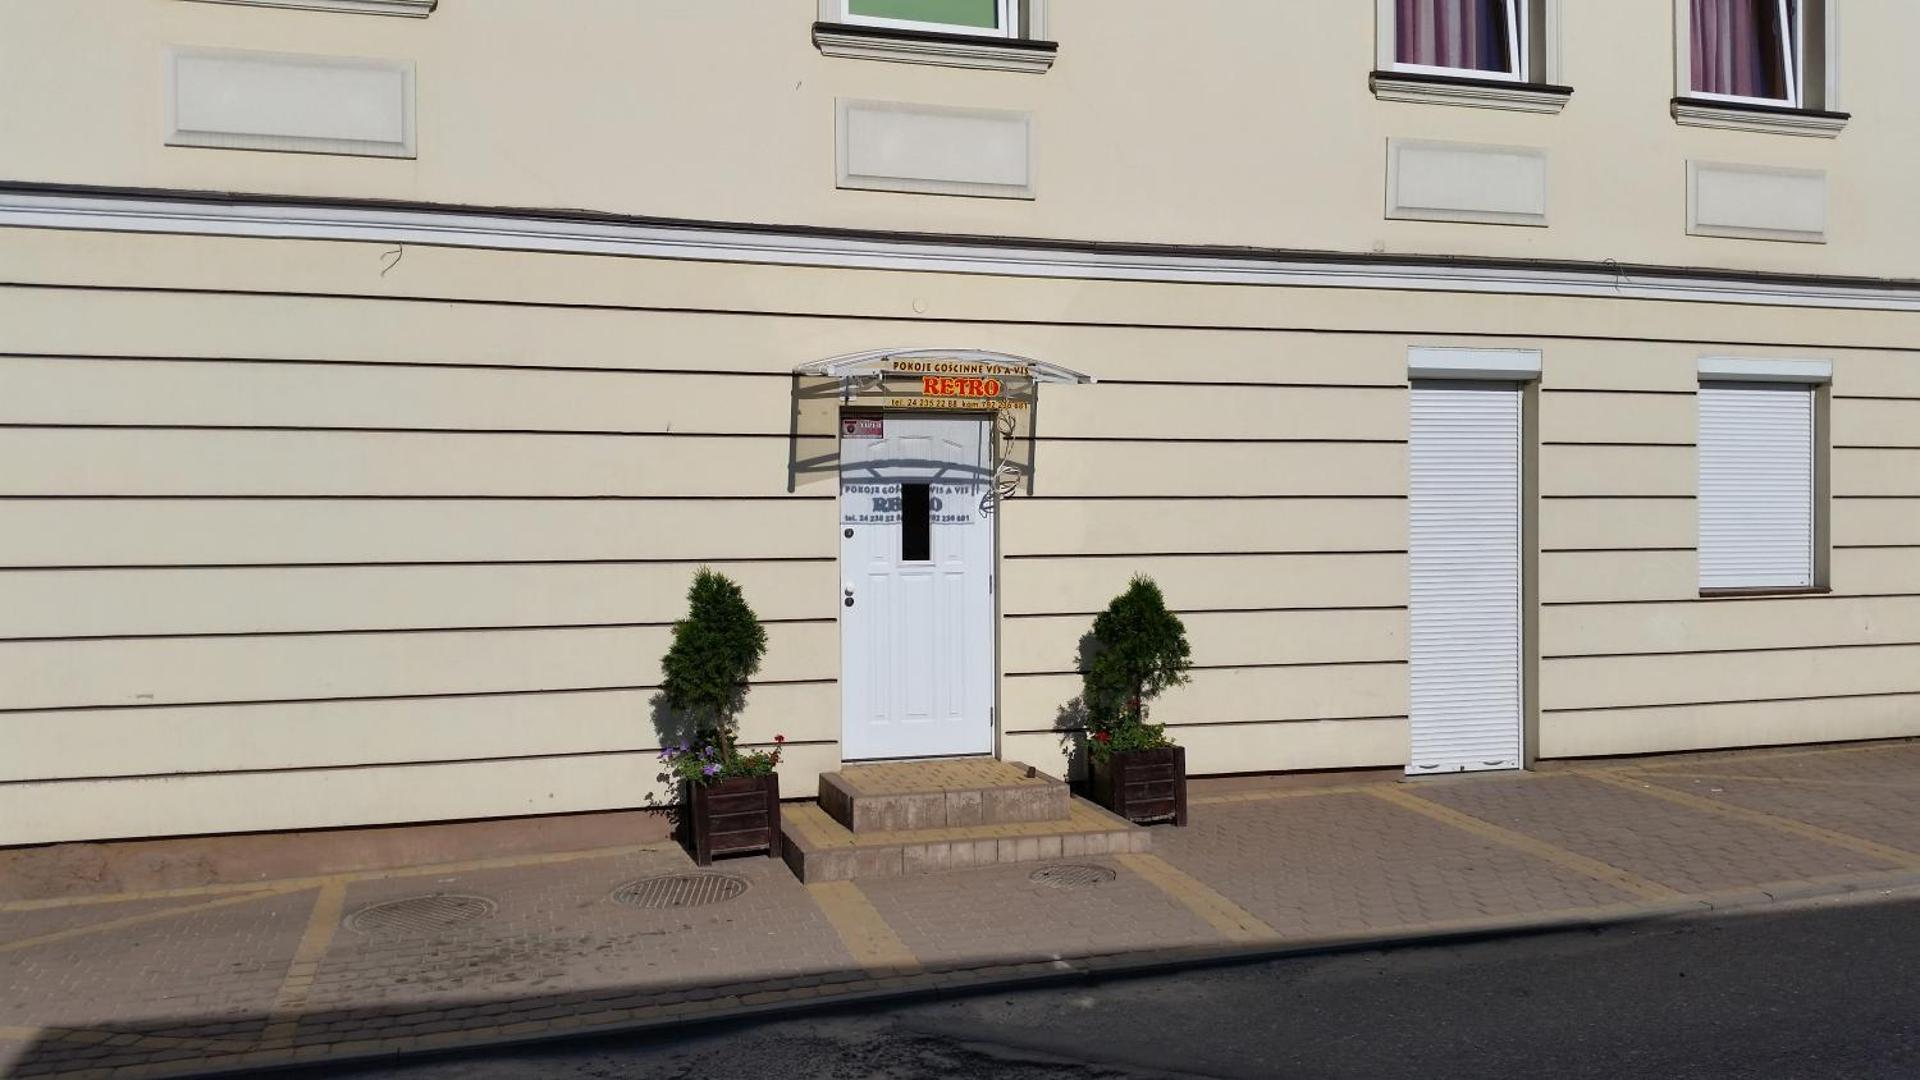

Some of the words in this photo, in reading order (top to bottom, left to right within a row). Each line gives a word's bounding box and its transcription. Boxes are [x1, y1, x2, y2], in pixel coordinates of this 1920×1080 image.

[893, 361, 931, 371] POKOJE
[986, 365, 1002, 374] VIS
[1014, 366, 1029, 375] VIS
[922, 376, 1001, 397] RETRO
